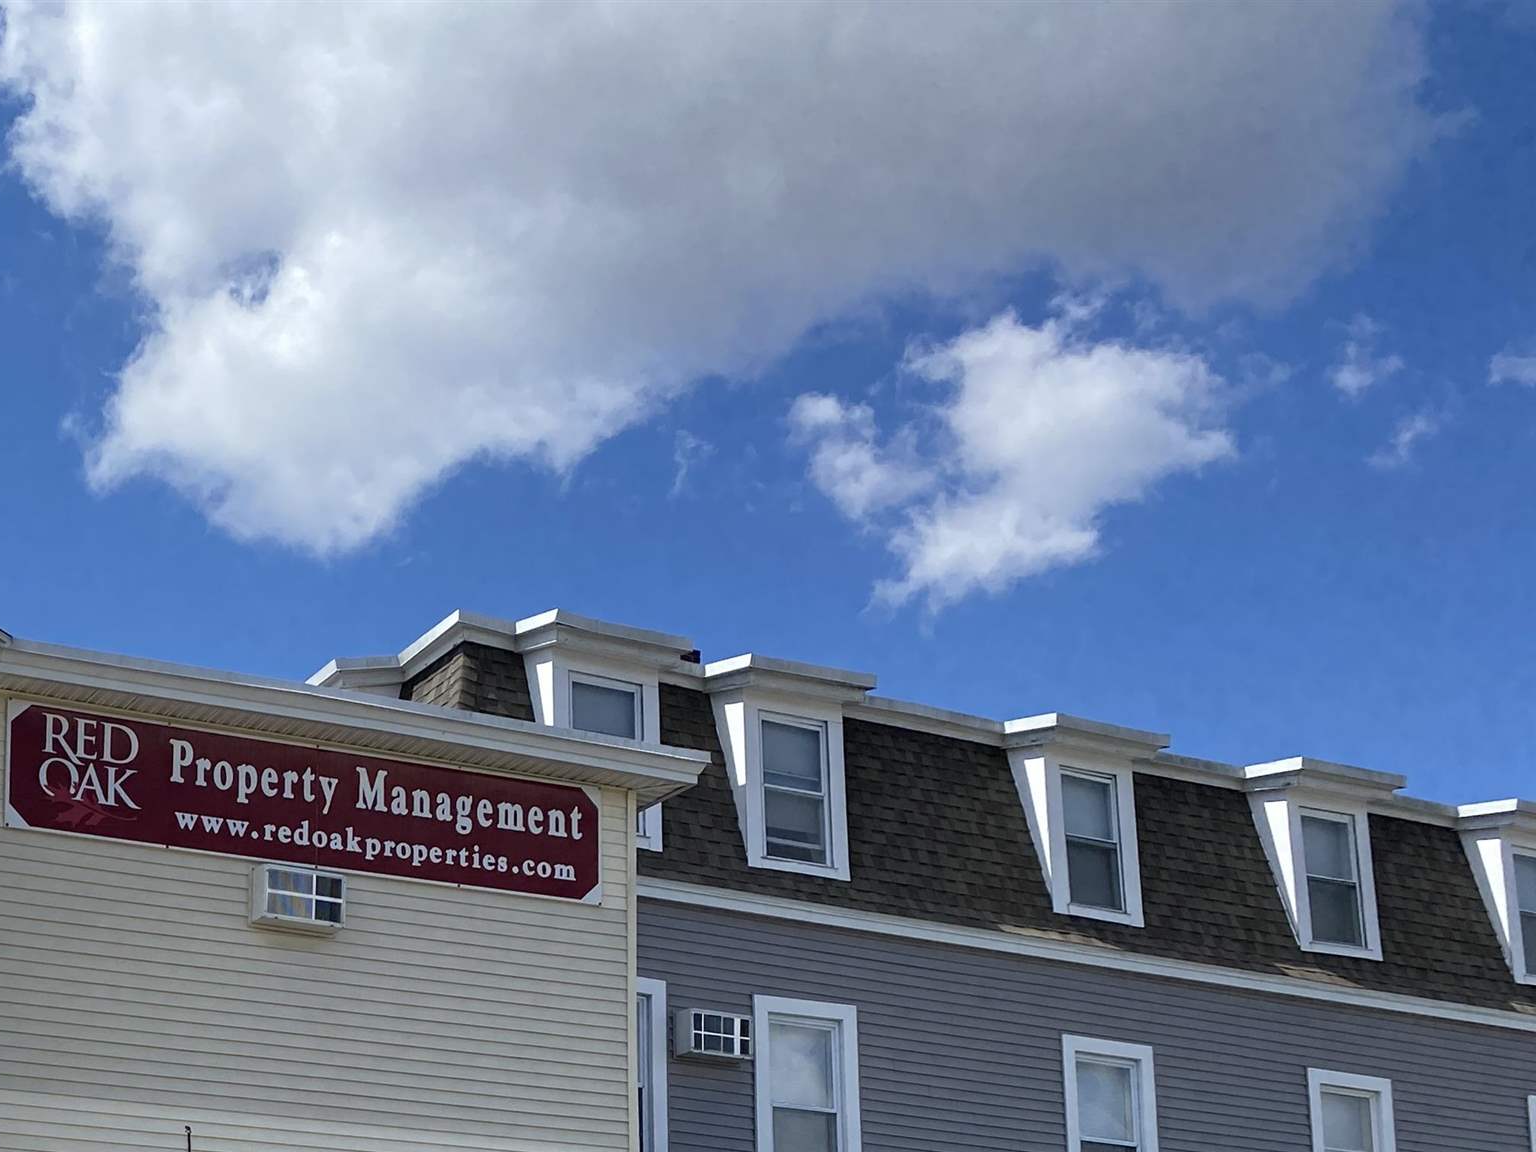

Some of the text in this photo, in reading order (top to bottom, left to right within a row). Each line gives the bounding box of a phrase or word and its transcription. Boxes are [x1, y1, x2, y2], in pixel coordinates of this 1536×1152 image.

[42, 712, 139, 766] RED
[38, 757, 142, 810] OAK
[169, 738, 583, 840] Property Management
[174, 811, 577, 881] www.redoakproperties.com
